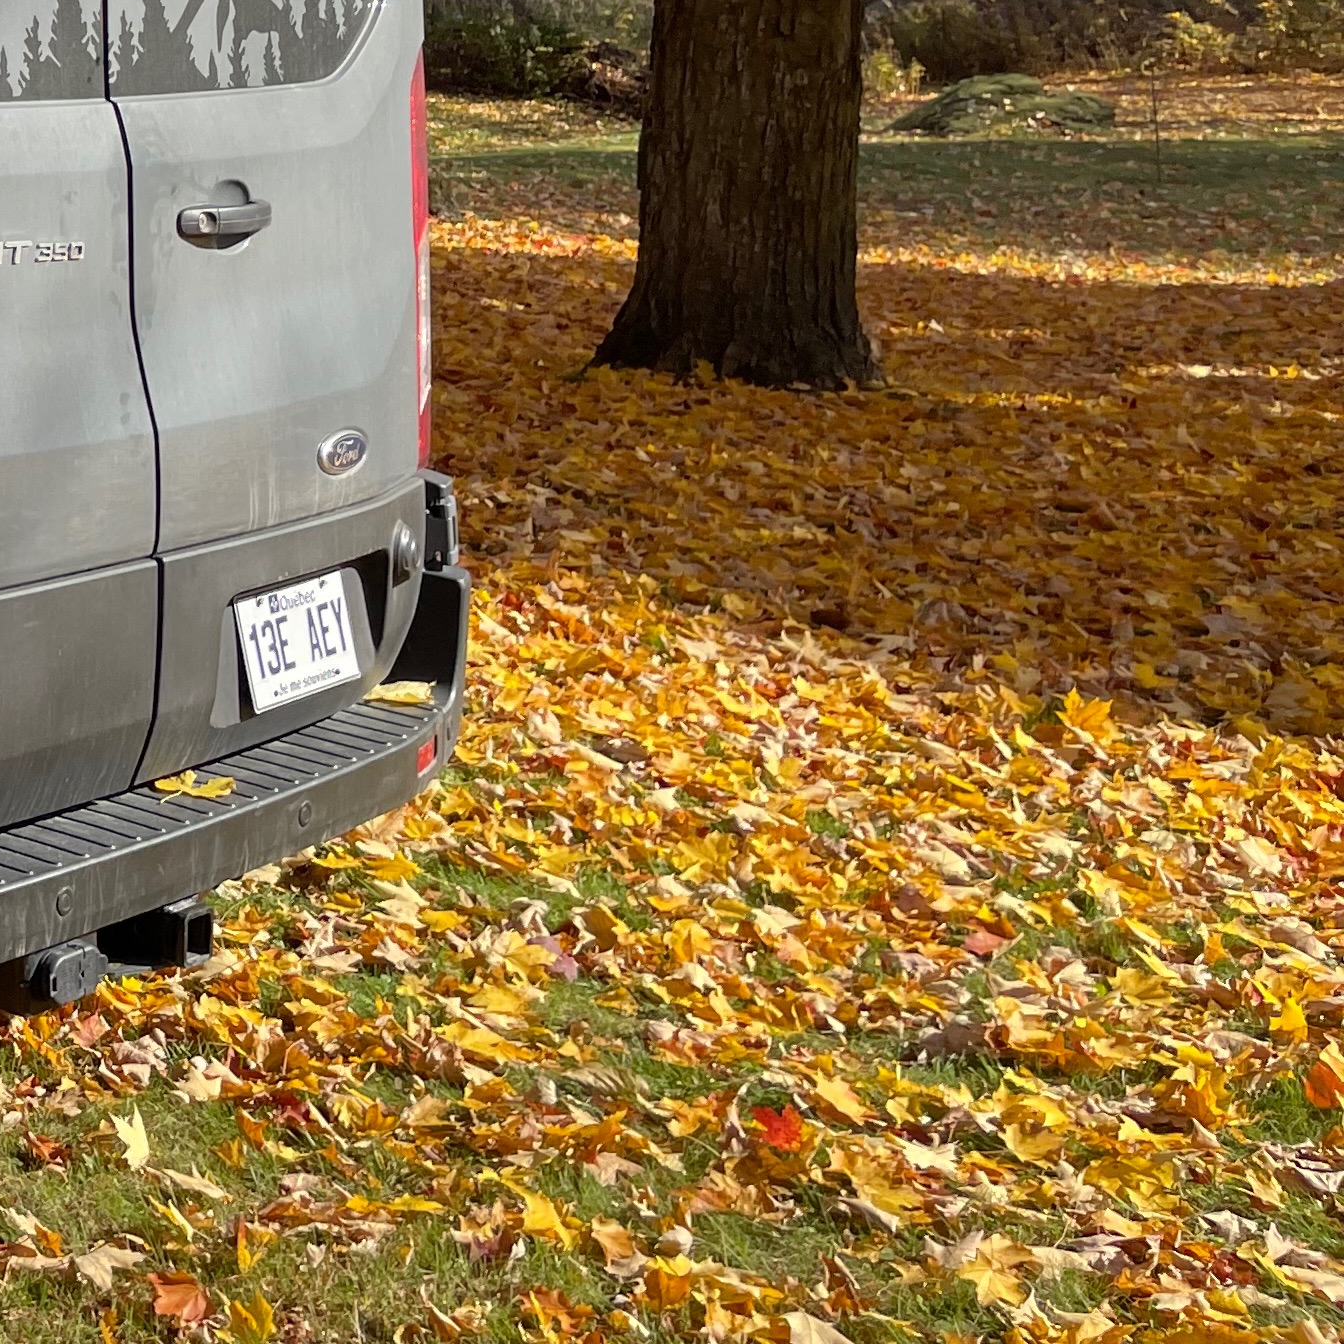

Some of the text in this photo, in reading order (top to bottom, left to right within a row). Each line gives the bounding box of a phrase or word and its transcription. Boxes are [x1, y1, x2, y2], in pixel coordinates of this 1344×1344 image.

[34, 240, 86, 264] 350
[333, 439, 361, 467] Ford
[248, 596, 348, 680] 13E AEY
